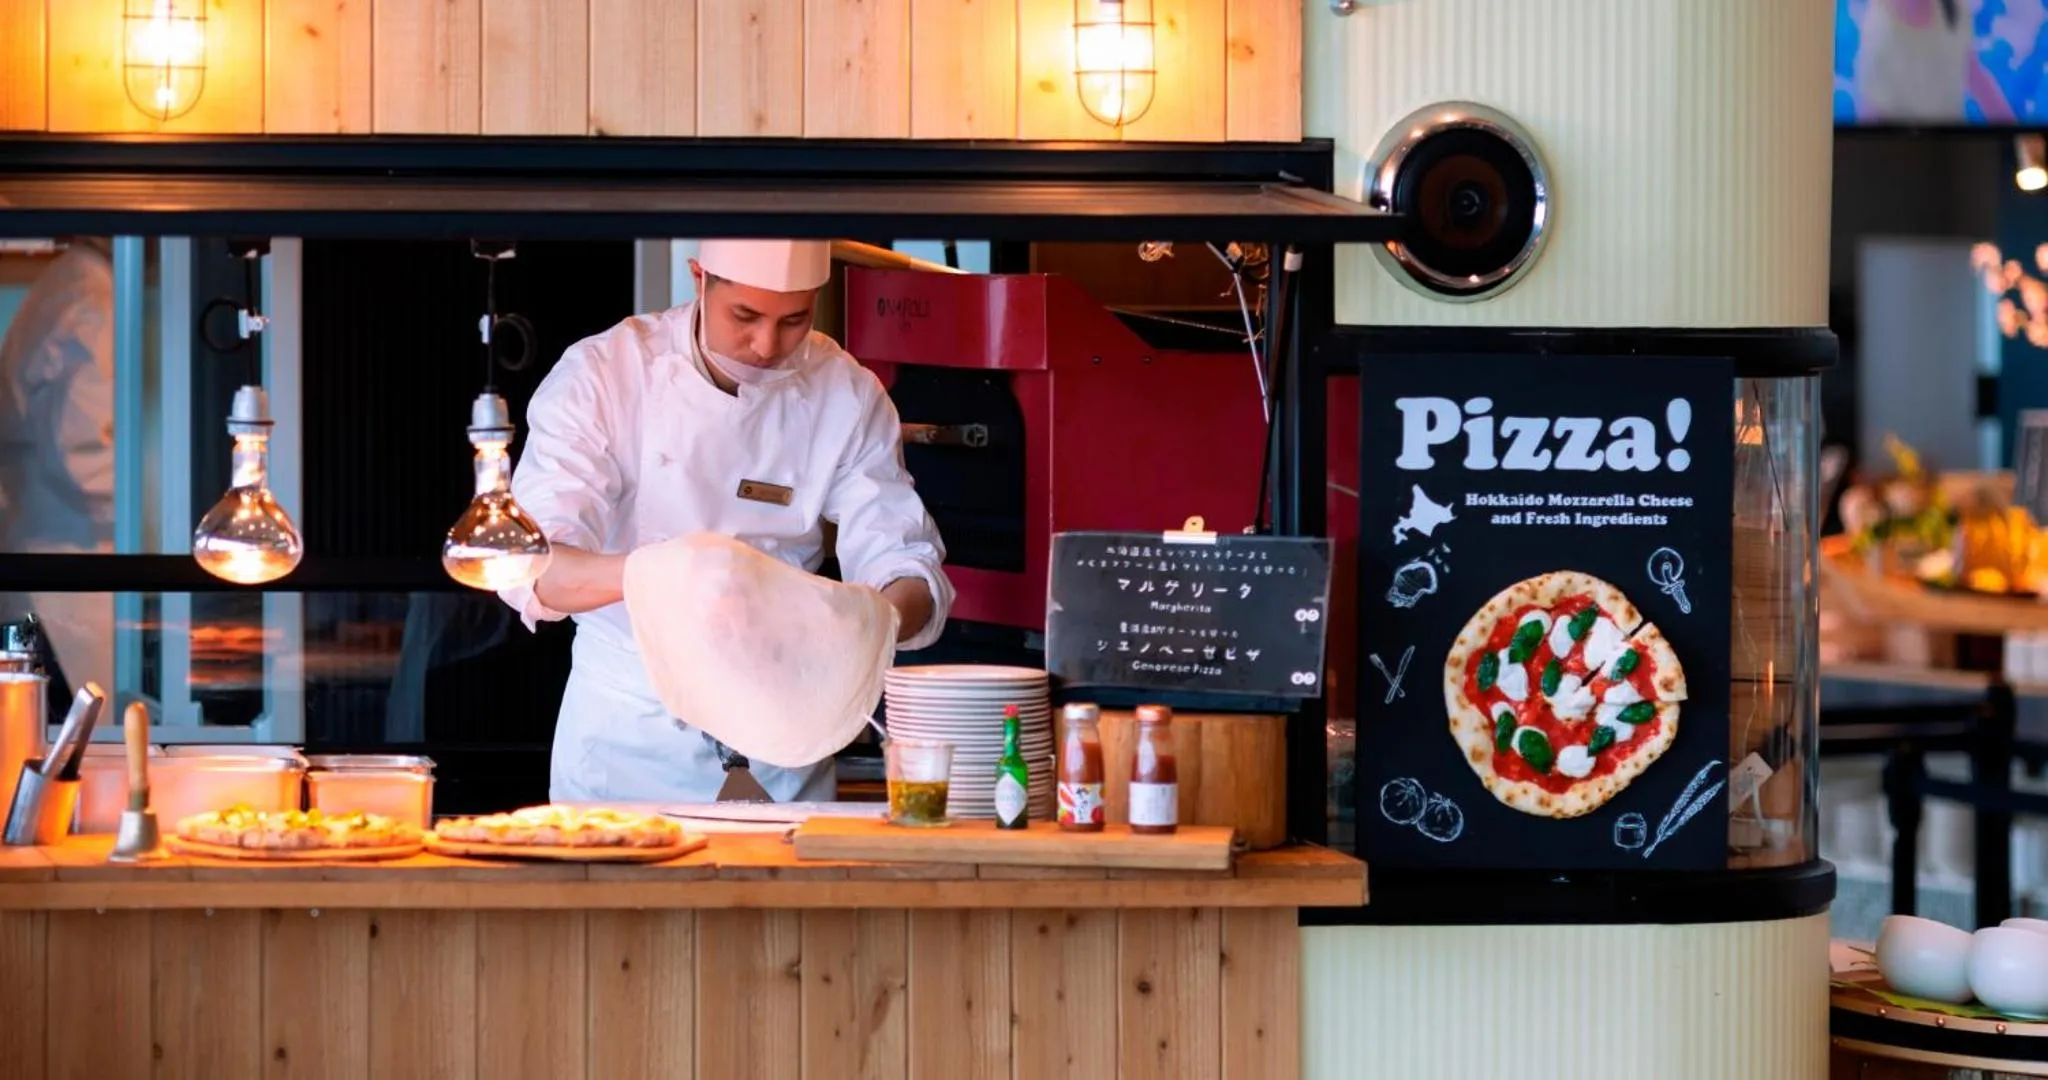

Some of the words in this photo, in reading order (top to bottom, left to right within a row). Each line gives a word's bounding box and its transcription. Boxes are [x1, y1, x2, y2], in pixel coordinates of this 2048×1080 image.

[1395, 397, 1692, 472] Pizza!
[1465, 493, 1545, 507] Hokkaido
[1548, 494, 1636, 507] Mozzarella
[1638, 494, 1694, 508] Cheese
[1491, 512, 1522, 526] and
[1525, 512, 1572, 526] Fresh
[1575, 513, 1668, 528] Ingredients
[1118, 578, 1252, 599] マルゲリータ
[1150, 600, 1212, 613] Margherita
[1132, 660, 1191, 673] Genovese
[1192, 663, 1222, 675] Pizza
